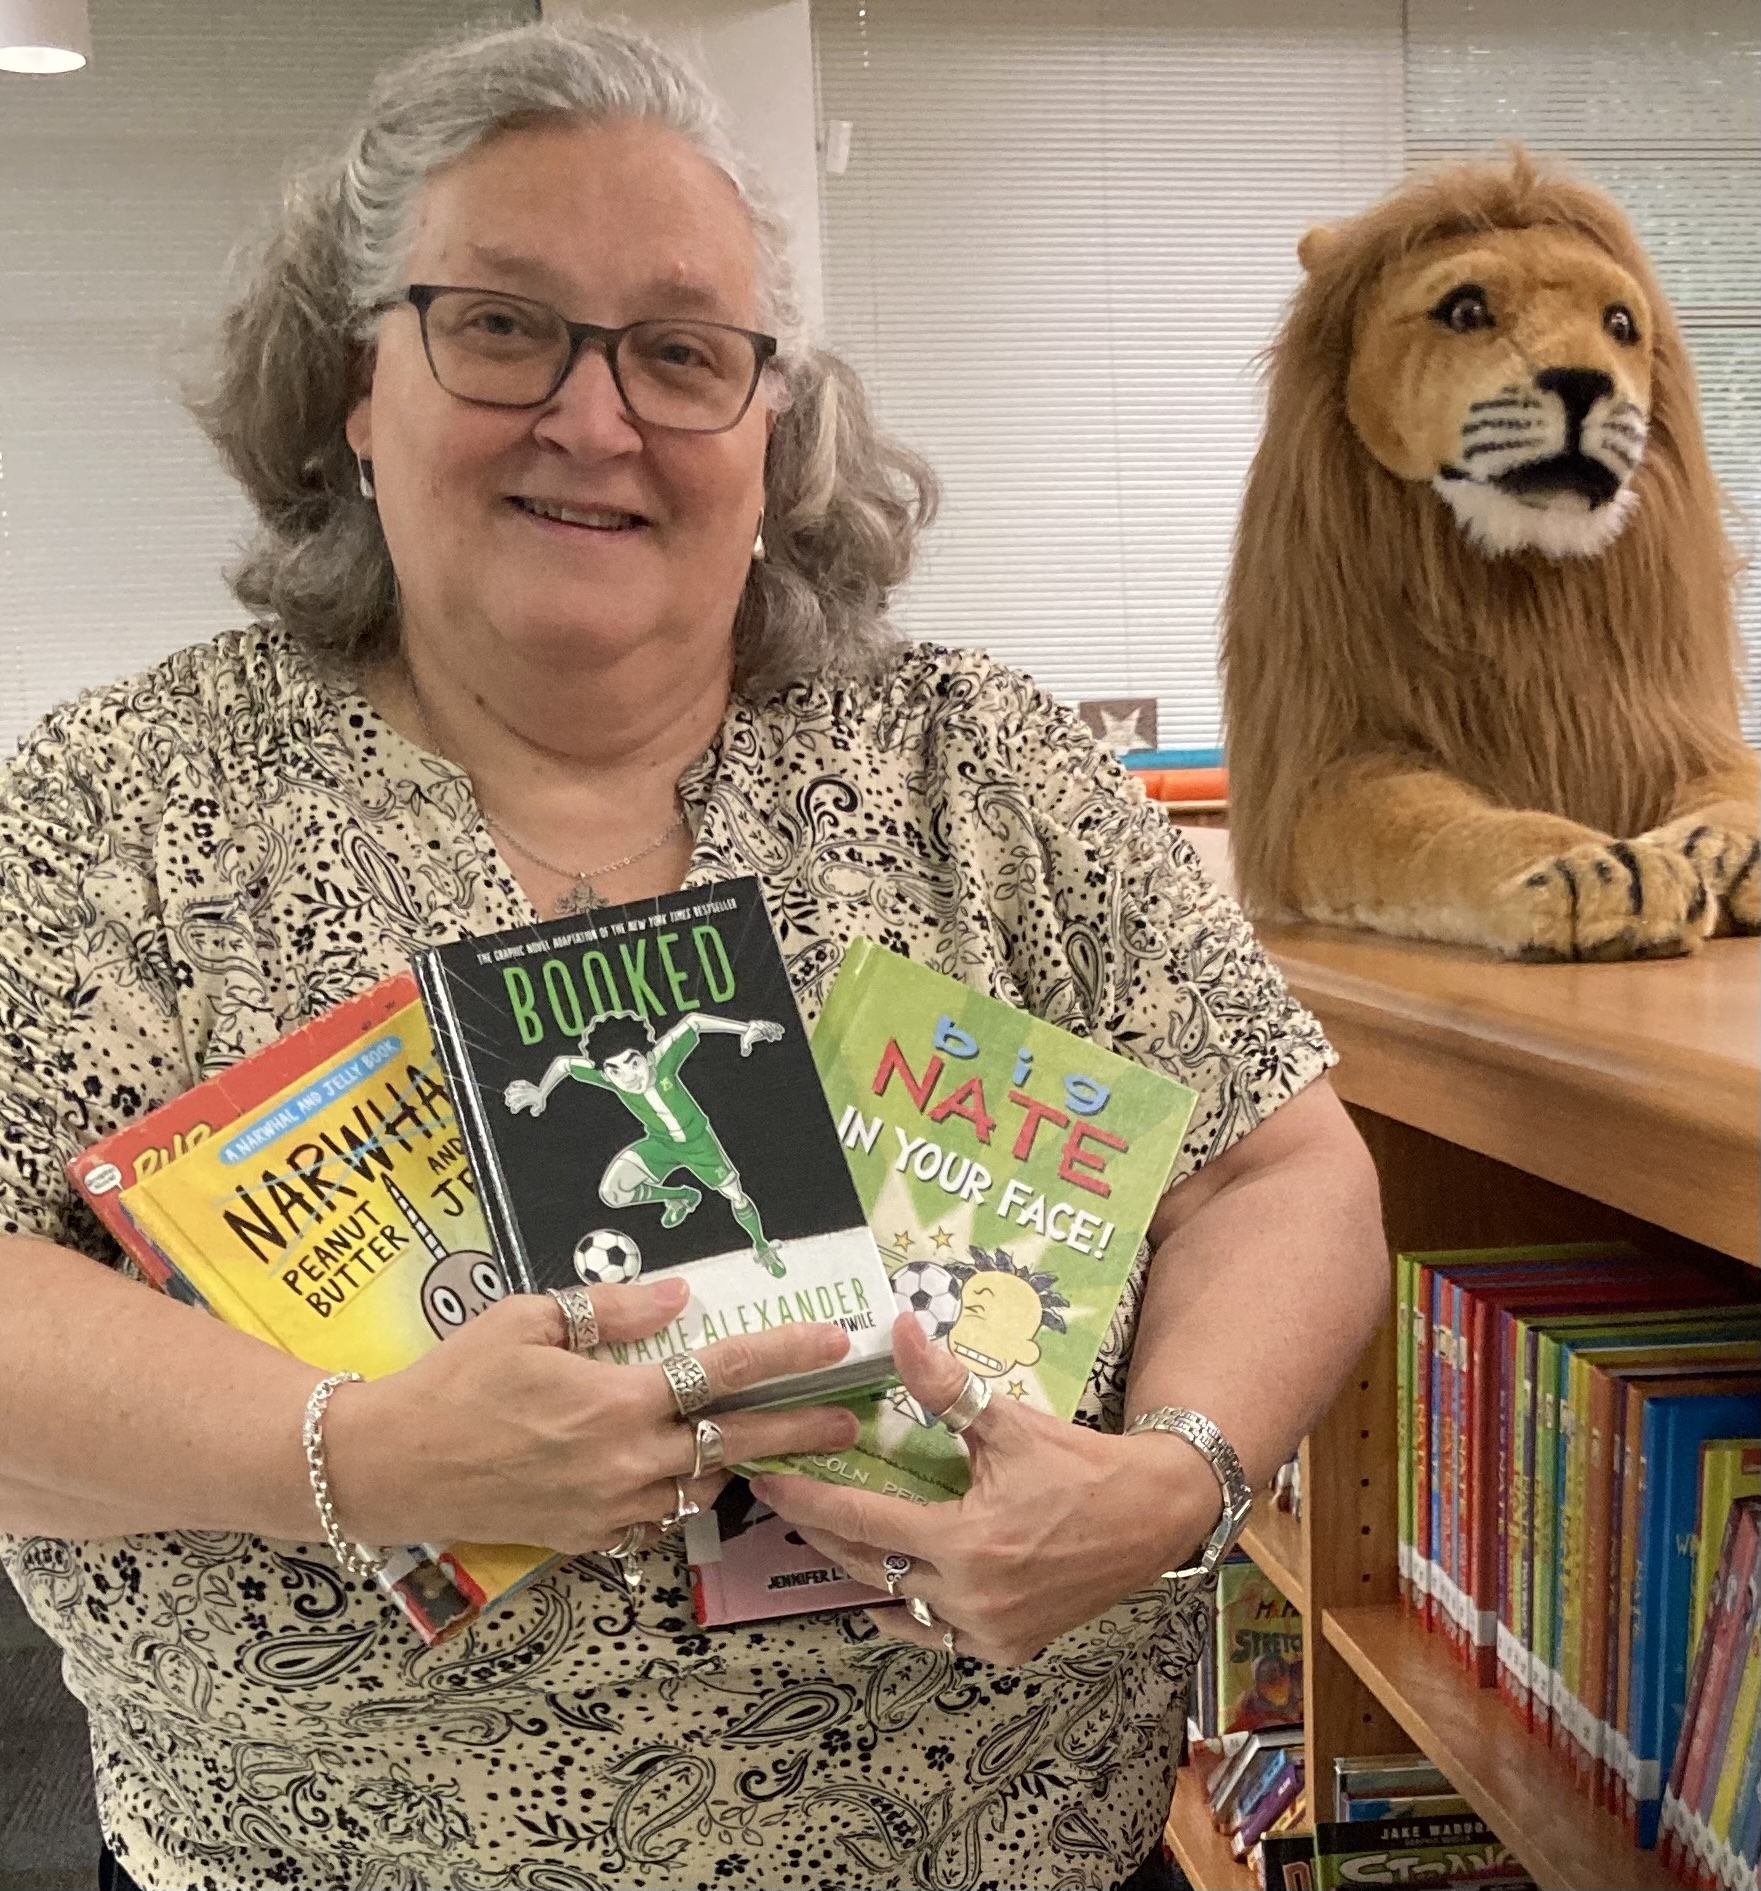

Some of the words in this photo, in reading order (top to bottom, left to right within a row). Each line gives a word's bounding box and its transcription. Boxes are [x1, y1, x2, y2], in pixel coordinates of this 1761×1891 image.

[476, 952, 493, 966] THE
[493, 945, 525, 962] GRAPHIC
[525, 940, 551, 954] NOVEL
[552, 929, 598, 949] ADAPTATION
[610, 922, 626, 936] THE
[627, 919, 646, 932] NEW
[647, 913, 668, 928] YORK
[669, 907, 692, 923] TIMES
[502, 924, 737, 1046] BOOKED
[225, 1148, 240, 1163] A
[235, 1108, 300, 1156] NARWHAL
[296, 1090, 323, 1116] AND
[322, 1064, 363, 1097] JELLY
[361, 1039, 397, 1070] BOOK
[872, 1037, 1129, 1199] NATE
[223, 1052, 452, 1264] NARWHA
[427, 1137, 466, 1176] AND
[838, 1104, 883, 1155] IN
[894, 1126, 992, 1205] YOUR
[996, 1178, 1115, 1259] FACE!
[282, 1200, 380, 1296] PEANUT
[306, 1225, 409, 1318] BUTTER
[702, 1277, 869, 1346] ALEXANDER
[805, 1455, 870, 1485] COLN
[767, 1569, 831, 1590] JENNIFER
[1380, 1825, 1421, 1841] JAKE
[1428, 1821, 1487, 1837] MADDO
